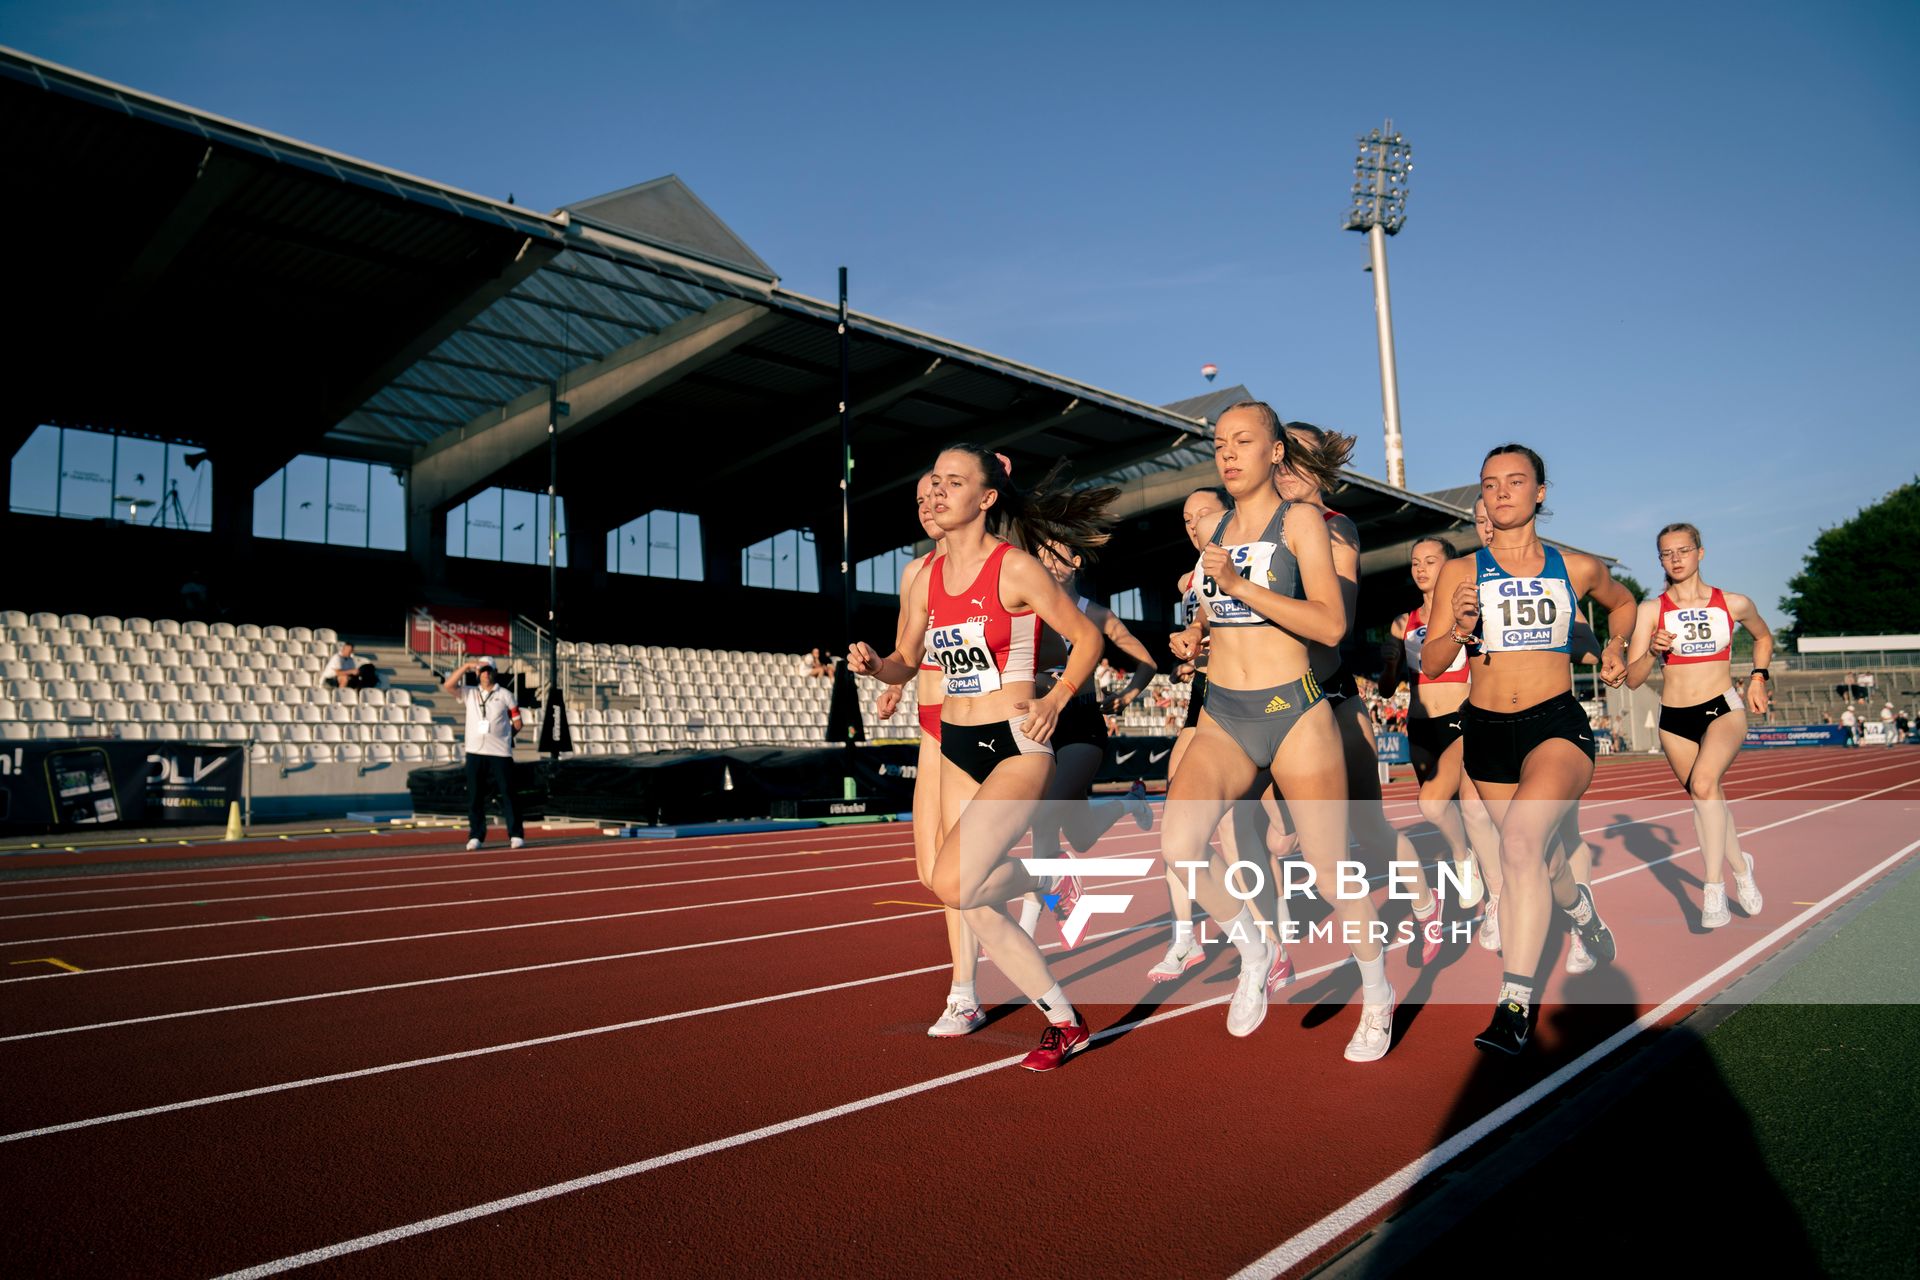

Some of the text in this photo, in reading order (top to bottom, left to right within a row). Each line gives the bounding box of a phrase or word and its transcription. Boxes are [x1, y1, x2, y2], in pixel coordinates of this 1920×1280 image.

[1203, 566, 1251, 598] 54
[1497, 598, 1557, 626] 150
[440, 619, 505, 637] Sparkasse
[1523, 631, 1550, 640] PLAN
[1684, 622, 1712, 641] 36
[958, 677, 978, 689] PLAN
[146, 754, 227, 784] DLV
